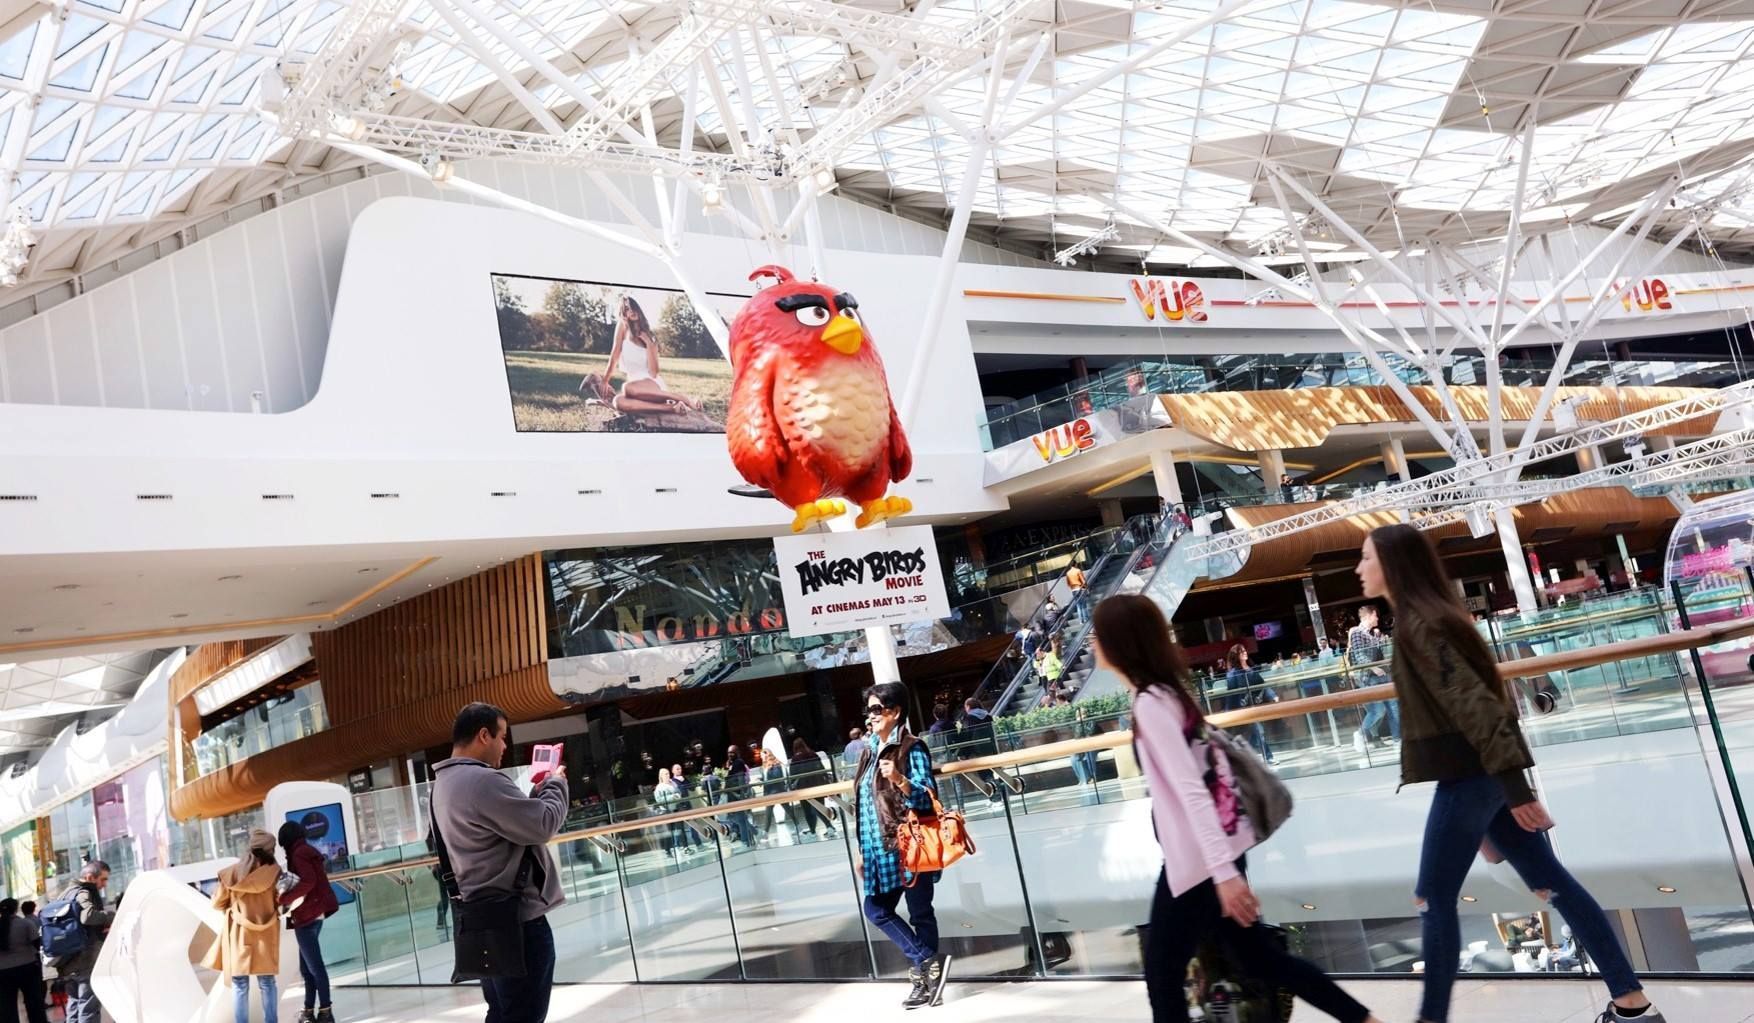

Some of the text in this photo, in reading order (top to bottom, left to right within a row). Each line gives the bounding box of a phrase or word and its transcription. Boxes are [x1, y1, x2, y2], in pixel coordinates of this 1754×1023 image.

[807, 550, 825, 561] THE
[795, 547, 926, 596] ANGRY BIRDS
[885, 575, 924, 591] MOVIE
[811, 606, 823, 616] AT
[826, 601, 870, 613] CINEMAS
[873, 597, 893, 608] MAY
[894, 596, 906, 605] 13
[913, 595, 927, 603] 3D
